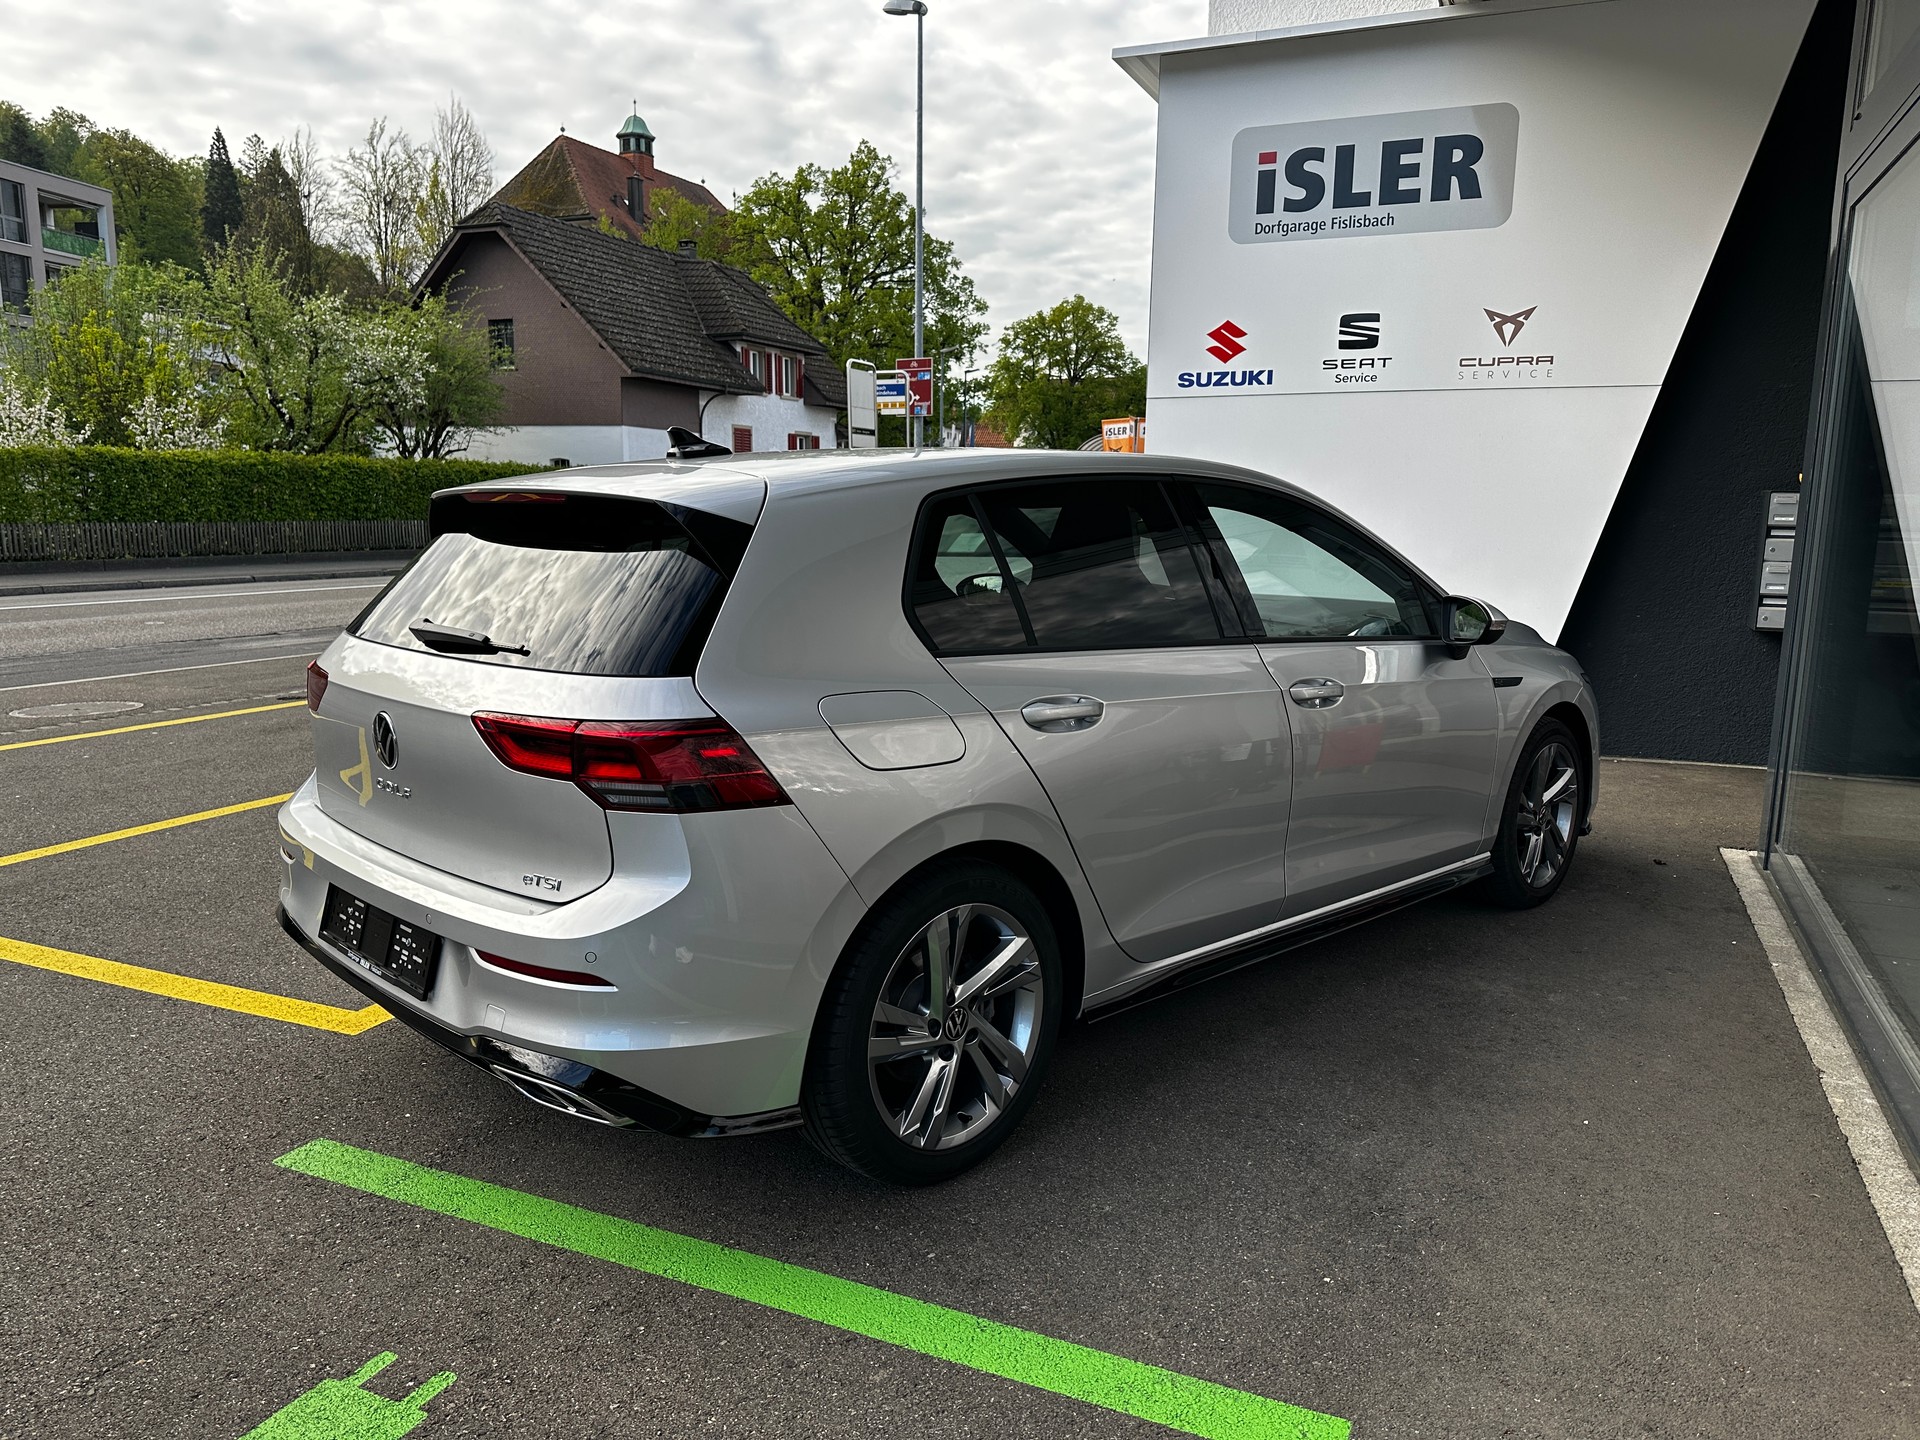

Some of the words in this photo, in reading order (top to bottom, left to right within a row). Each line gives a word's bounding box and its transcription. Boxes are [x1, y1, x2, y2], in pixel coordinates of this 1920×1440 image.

[1254, 220, 1327, 237] Dorfgarage
[1331, 212, 1395, 230] Fislisbach
[1322, 357, 1393, 370] SEAT
[1459, 355, 1554, 367] CUPRA
[1177, 369, 1274, 388] SUZUKI
[1334, 372, 1378, 383] Service
[1458, 369, 1553, 380] SERVICE
[377, 777, 411, 799] GOLF
[522, 873, 562, 892] eTSI
